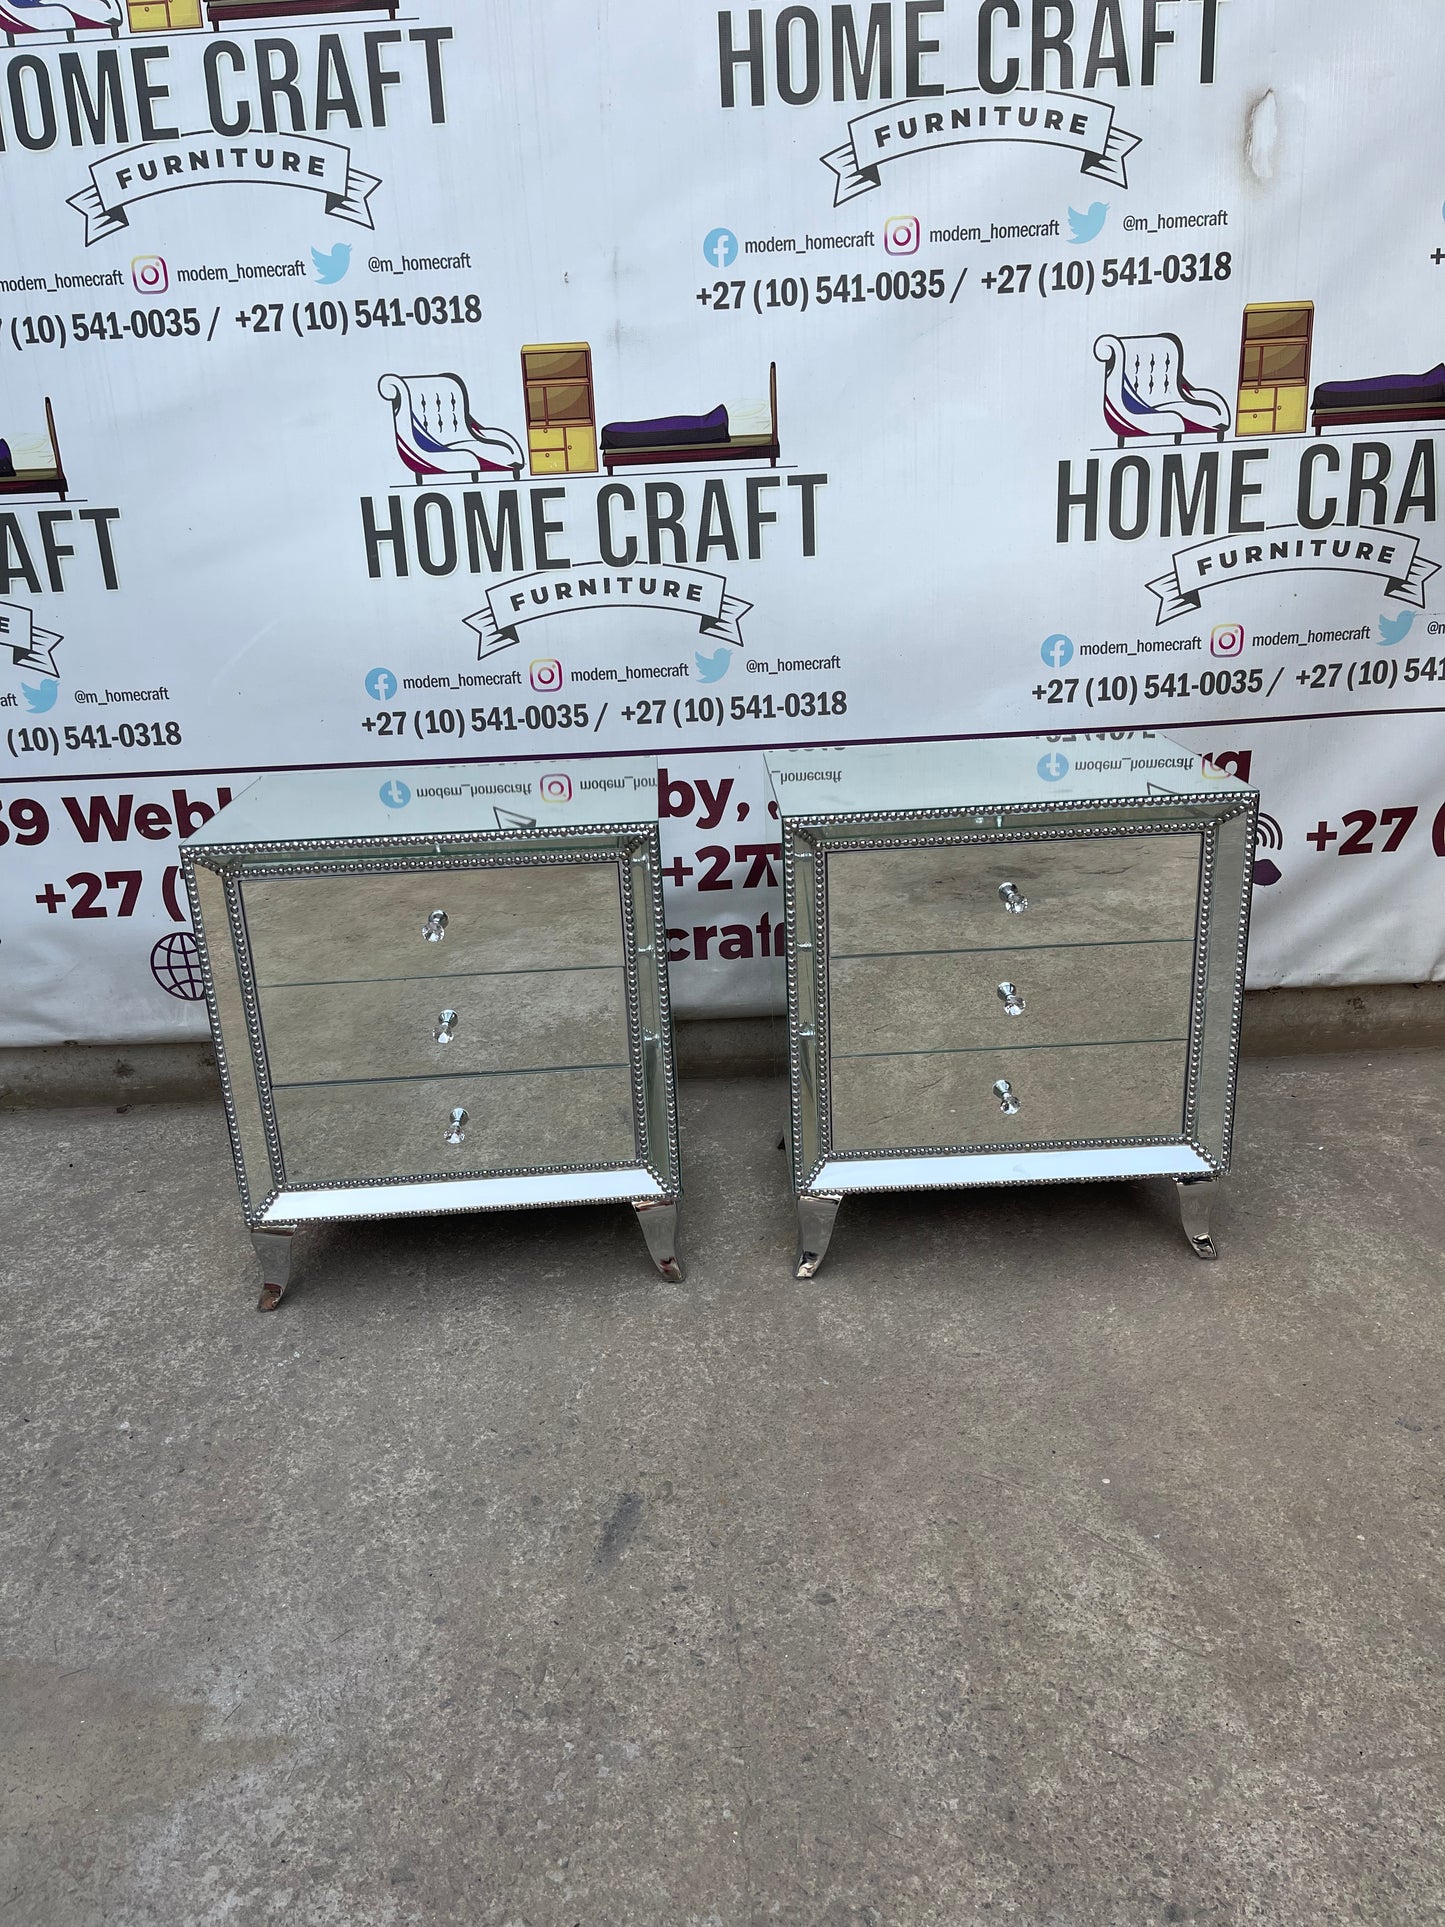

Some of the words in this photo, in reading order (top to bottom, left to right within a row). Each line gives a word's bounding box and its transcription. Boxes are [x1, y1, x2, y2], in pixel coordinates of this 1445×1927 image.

[718, 0, 945, 109] HOME
[978, 0, 1217, 95] CRAFT
[0, 46, 180, 153] OME
[203, 27, 454, 138] CRAFT
[873, 106, 1089, 149] FURNITURE
[115, 148, 326, 191] FURNITURE
[744, 230, 876, 255] modern_homecraft
[929, 218, 1060, 244] modern_homecraft
[1122, 209, 1229, 234] @m_homecraft
[176, 259, 307, 283] modern_homecraft
[367, 251, 472, 276] @m_homecraft
[696, 280, 746, 311] +27
[753, 276, 809, 315] (10)
[815, 268, 946, 305] 541-0035
[981, 264, 1032, 295] +27
[1038, 259, 1095, 298] (10)
[1101, 251, 1232, 288] 541-0318
[11, 313, 67, 352] (10)
[71, 307, 201, 343] 541-0035
[234, 303, 285, 333] +27
[292, 300, 349, 338] (10)
[354, 293, 483, 329] 541-0318
[1056, 447, 1270, 544] HOME
[1297, 438, 1437, 531] CRA
[360, 486, 572, 579] HOME
[597, 472, 828, 568] CRAFT
[1196, 539, 1397, 577] FURNITURE
[509, 577, 704, 613] FURNITURE
[1080, 635, 1203, 657] modern_homecraft
[1252, 625, 1371, 647] modern_homecraft
[74, 686, 171, 706] @m_homecraft
[402, 670, 523, 690] modern_homecraft
[570, 662, 690, 683] modern_homecraft
[745, 654, 842, 676] @m_homecraft
[1031, 678, 1080, 705] +27
[1085, 675, 1138, 708] (10)
[1144, 668, 1264, 701] 541-0035
[1296, 662, 1343, 689] +27
[1346, 659, 1398, 692] (10)
[7, 726, 60, 758] (10)
[63, 720, 183, 751] 541-0318
[361, 711, 407, 736] +27
[413, 708, 466, 740] (10)
[471, 703, 590, 733] 541-0035
[621, 699, 667, 725] +27
[673, 696, 725, 729] (10)
[730, 690, 848, 721] 541-0318
[0, 797, 50, 847] 9
[1306, 805, 1419, 857] +27
[35, 869, 143, 920] +27
